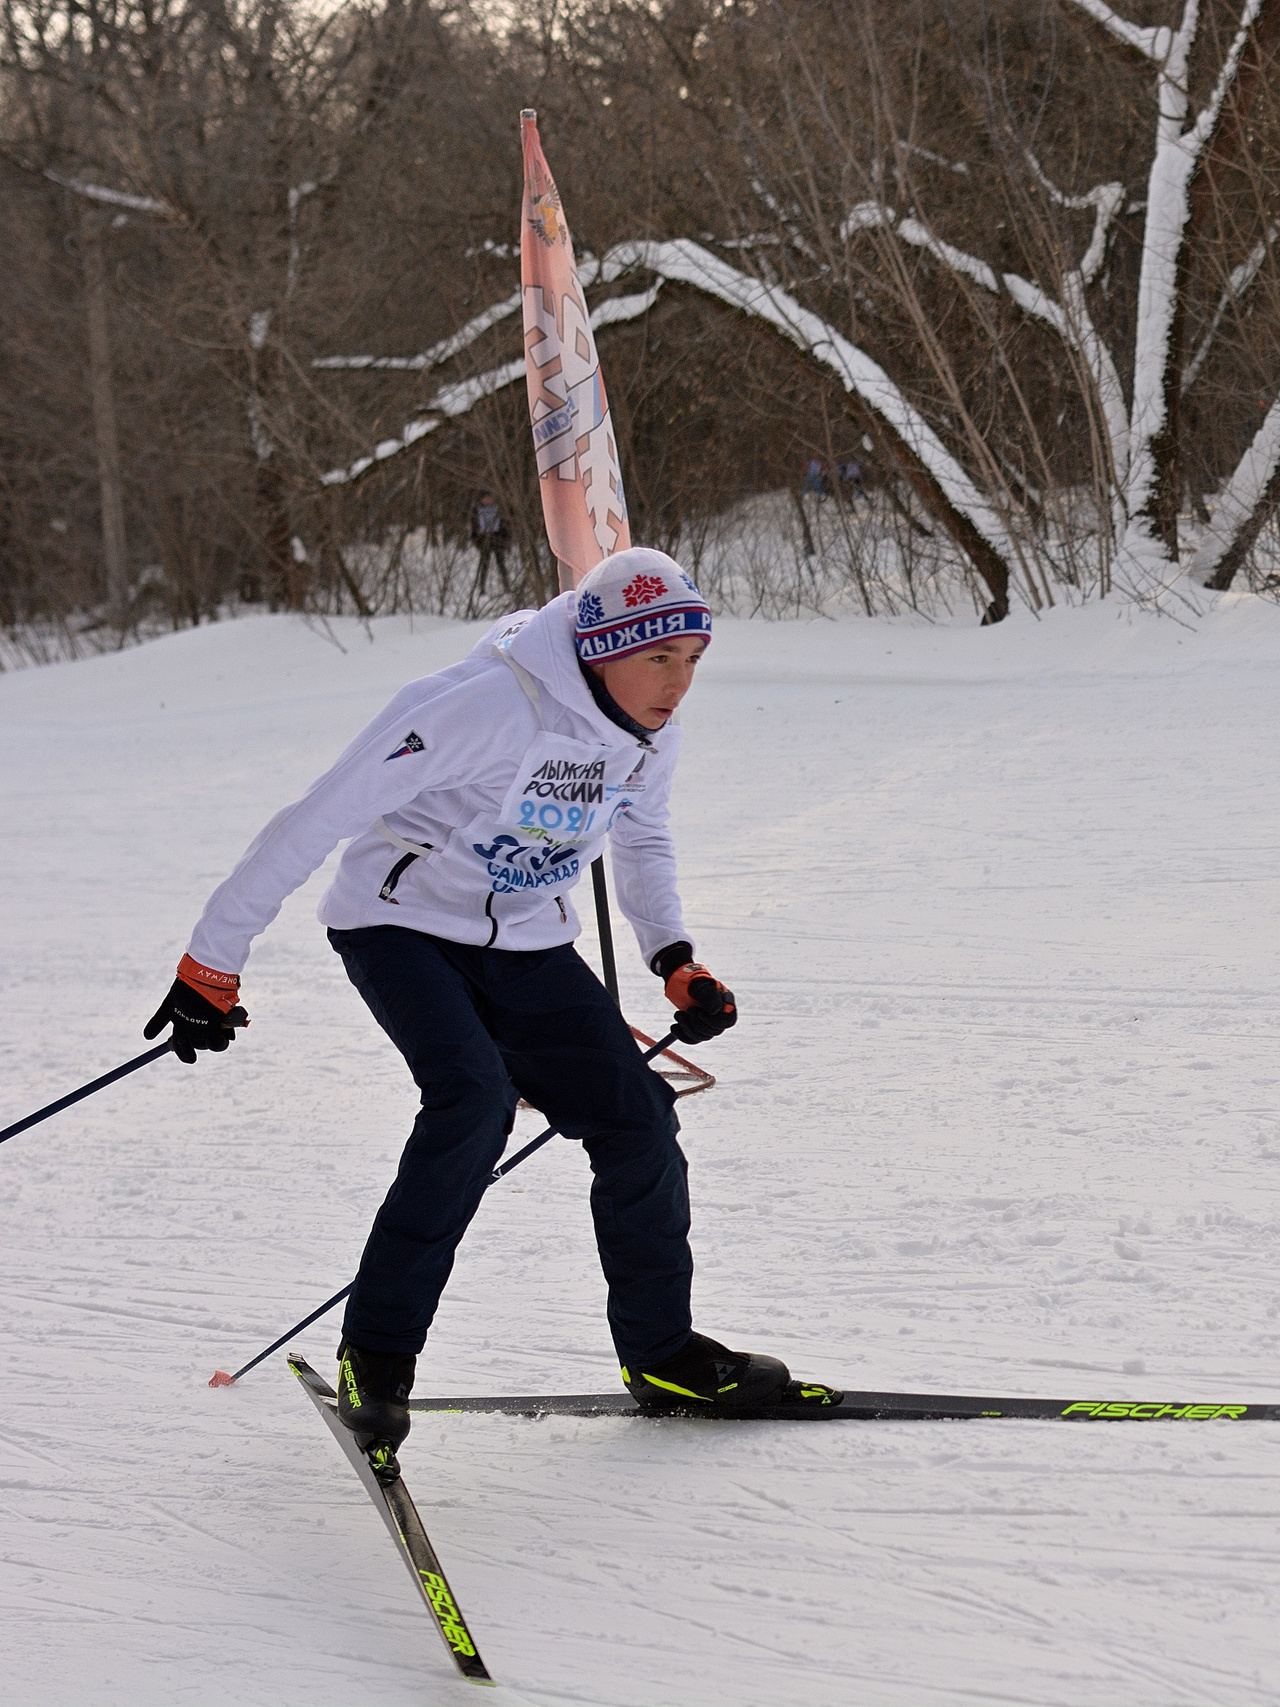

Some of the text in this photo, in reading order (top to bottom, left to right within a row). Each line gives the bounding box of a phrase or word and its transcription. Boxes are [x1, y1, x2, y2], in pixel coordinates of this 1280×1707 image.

[581, 613, 686, 657] ЛЫЖНЯ
[531, 760, 606, 780] ЛЫЖНЯ
[523, 780, 603, 804] РОССИИ
[517, 800, 596, 832] 2021
[173, 1007, 209, 1025] MADSHUS
[343, 1360, 362, 1409] FISCHER
[1061, 1402, 1248, 1419] FISCHER
[418, 1569, 476, 1657] FISCHER
